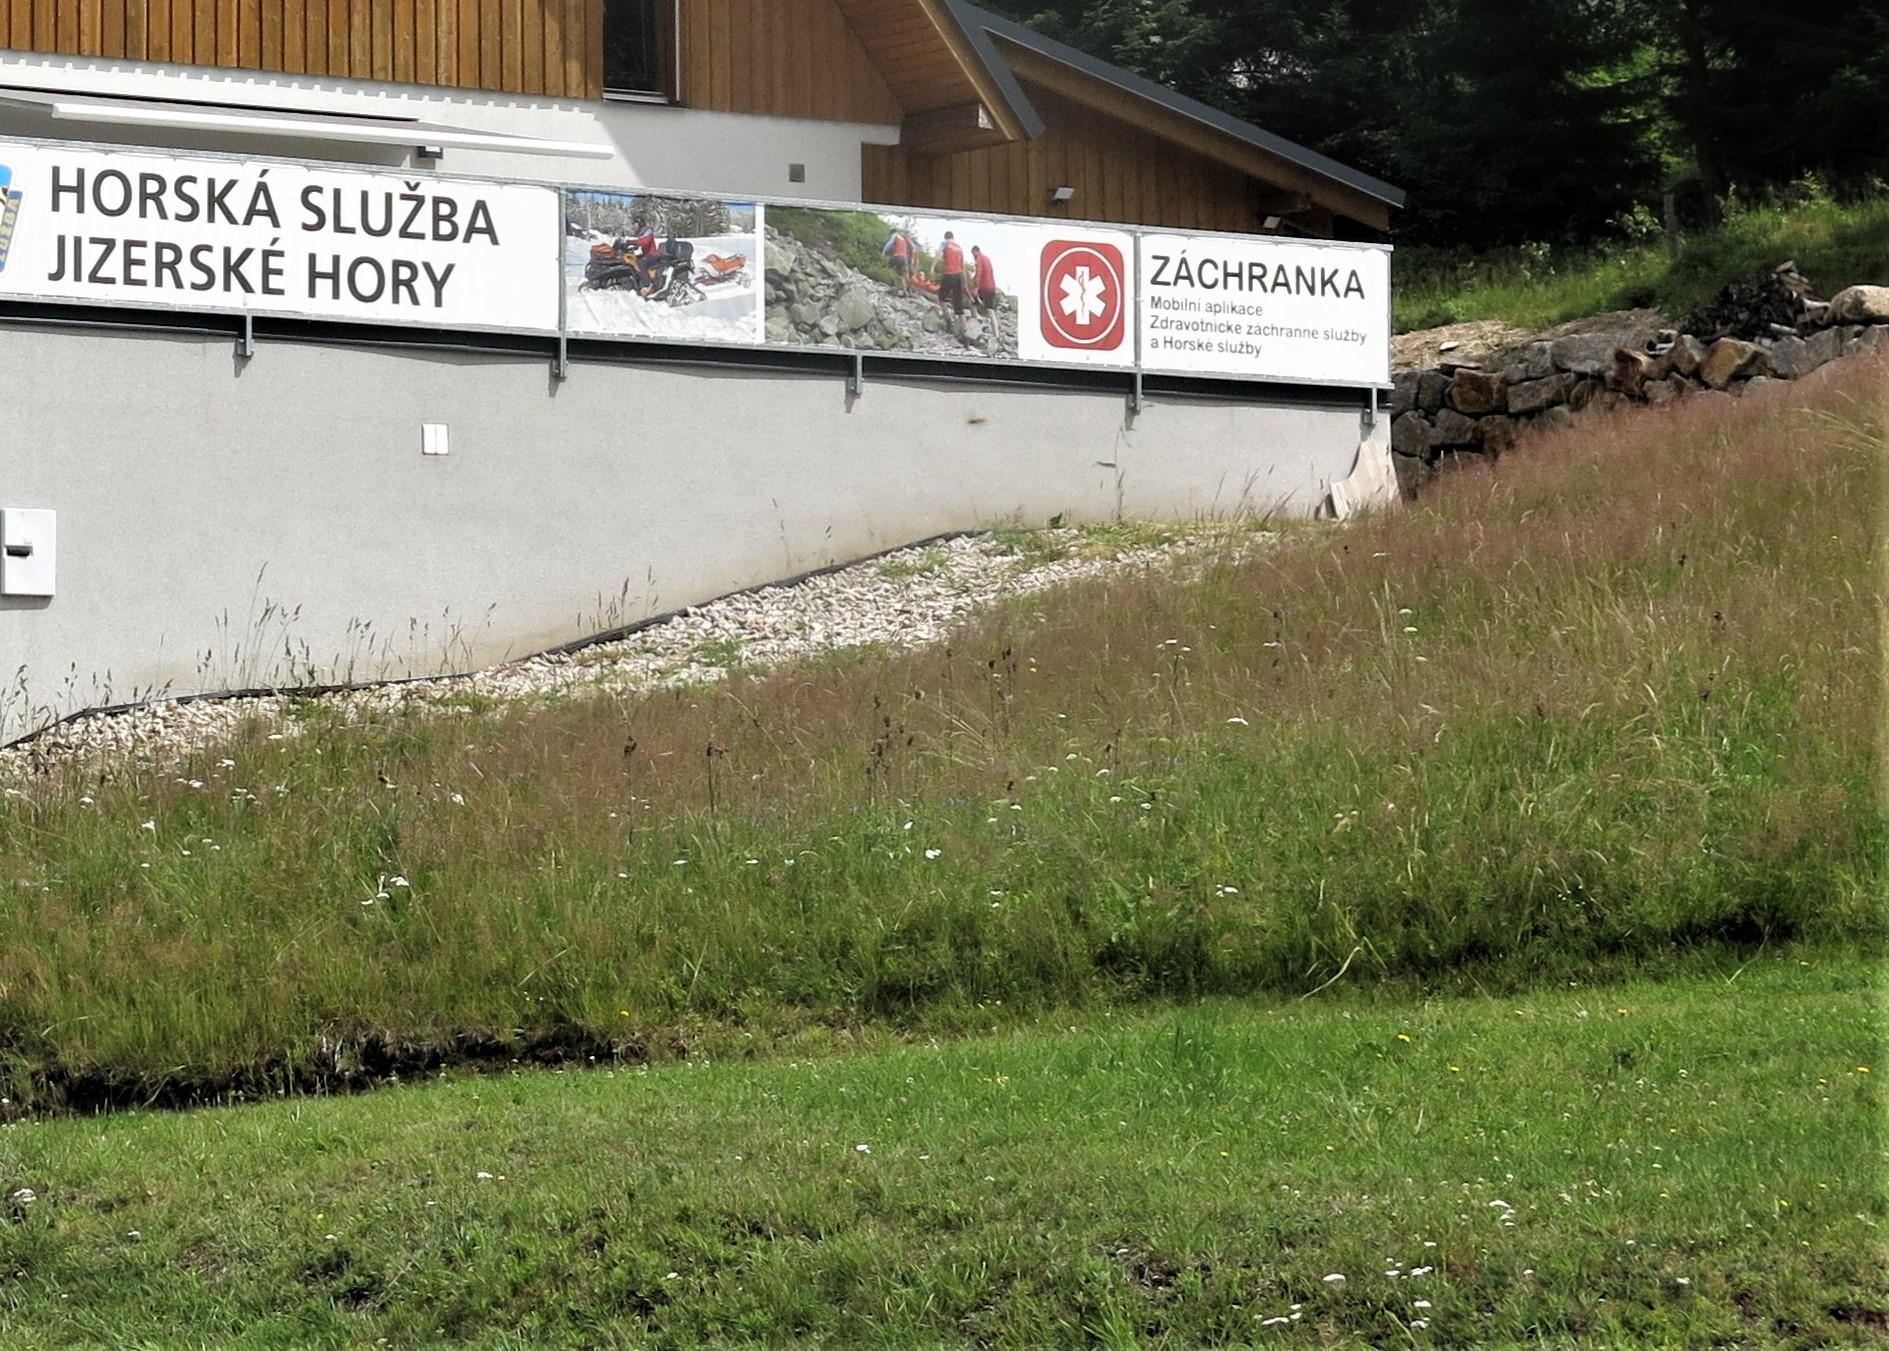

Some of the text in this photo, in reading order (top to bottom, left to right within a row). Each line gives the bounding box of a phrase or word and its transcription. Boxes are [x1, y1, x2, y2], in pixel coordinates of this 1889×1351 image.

[50, 167, 500, 246] HORSKÁ SLUŽBA
[48, 235, 456, 308] JIZERSKÉ HORY
[1150, 249, 1365, 299] ZÁCHRANKA
[1204, 300, 1263, 317] aplikace
[1150, 335, 1262, 359] a Horské služby
[1323, 327, 1367, 346] služby
